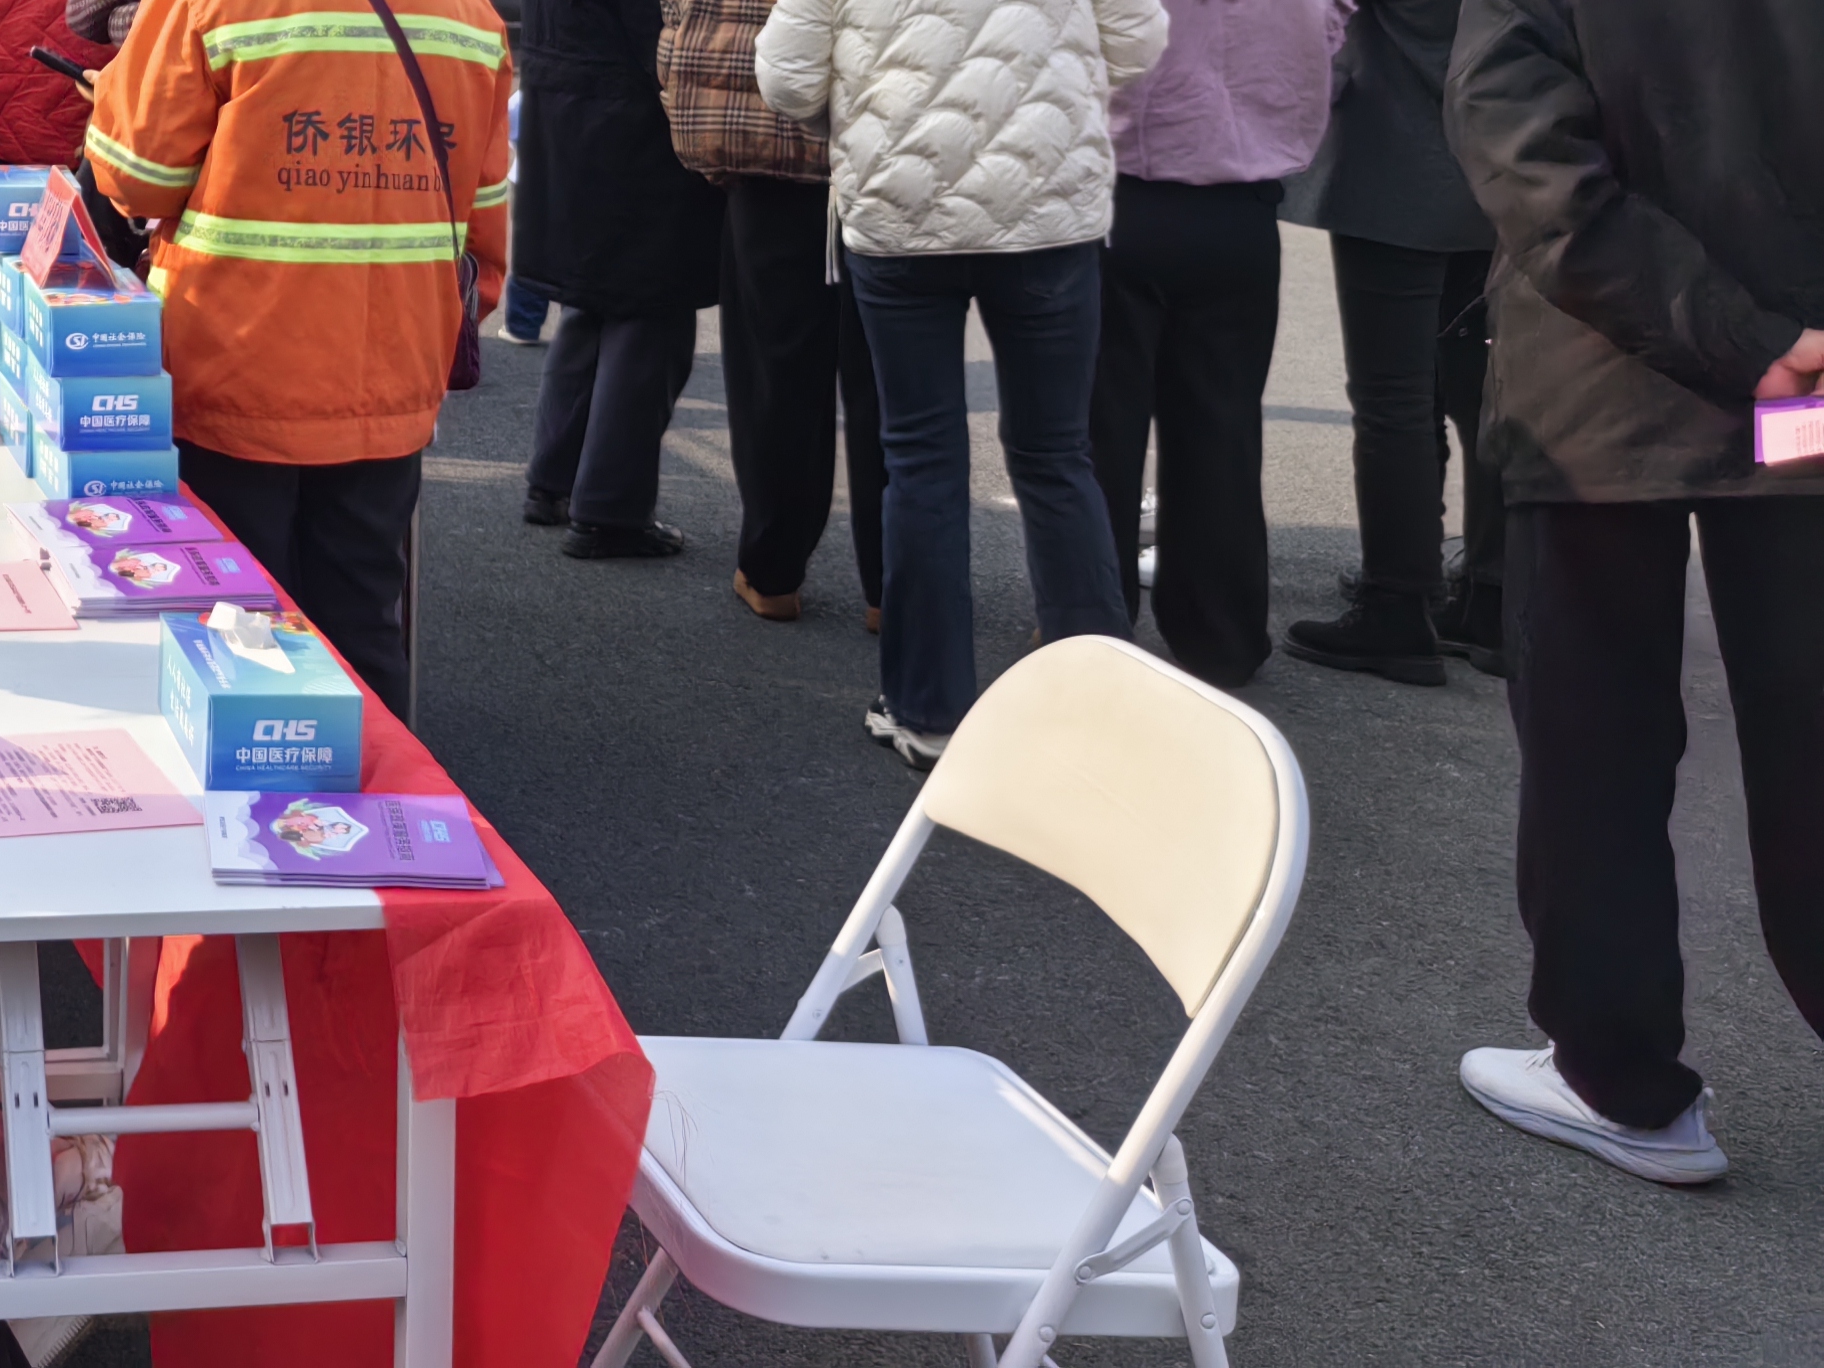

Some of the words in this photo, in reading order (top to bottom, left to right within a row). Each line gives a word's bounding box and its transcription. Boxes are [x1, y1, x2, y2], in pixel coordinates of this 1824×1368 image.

[277, 161, 331, 192] qiao
[92, 332, 146, 343] 中国社会保险
[92, 395, 140, 412] CHS
[80, 414, 150, 428] 中国医疗保障
[110, 479, 164, 491] 中国社会保险
[252, 719, 318, 741] CHS
[236, 746, 333, 764] 中国医疗保障
